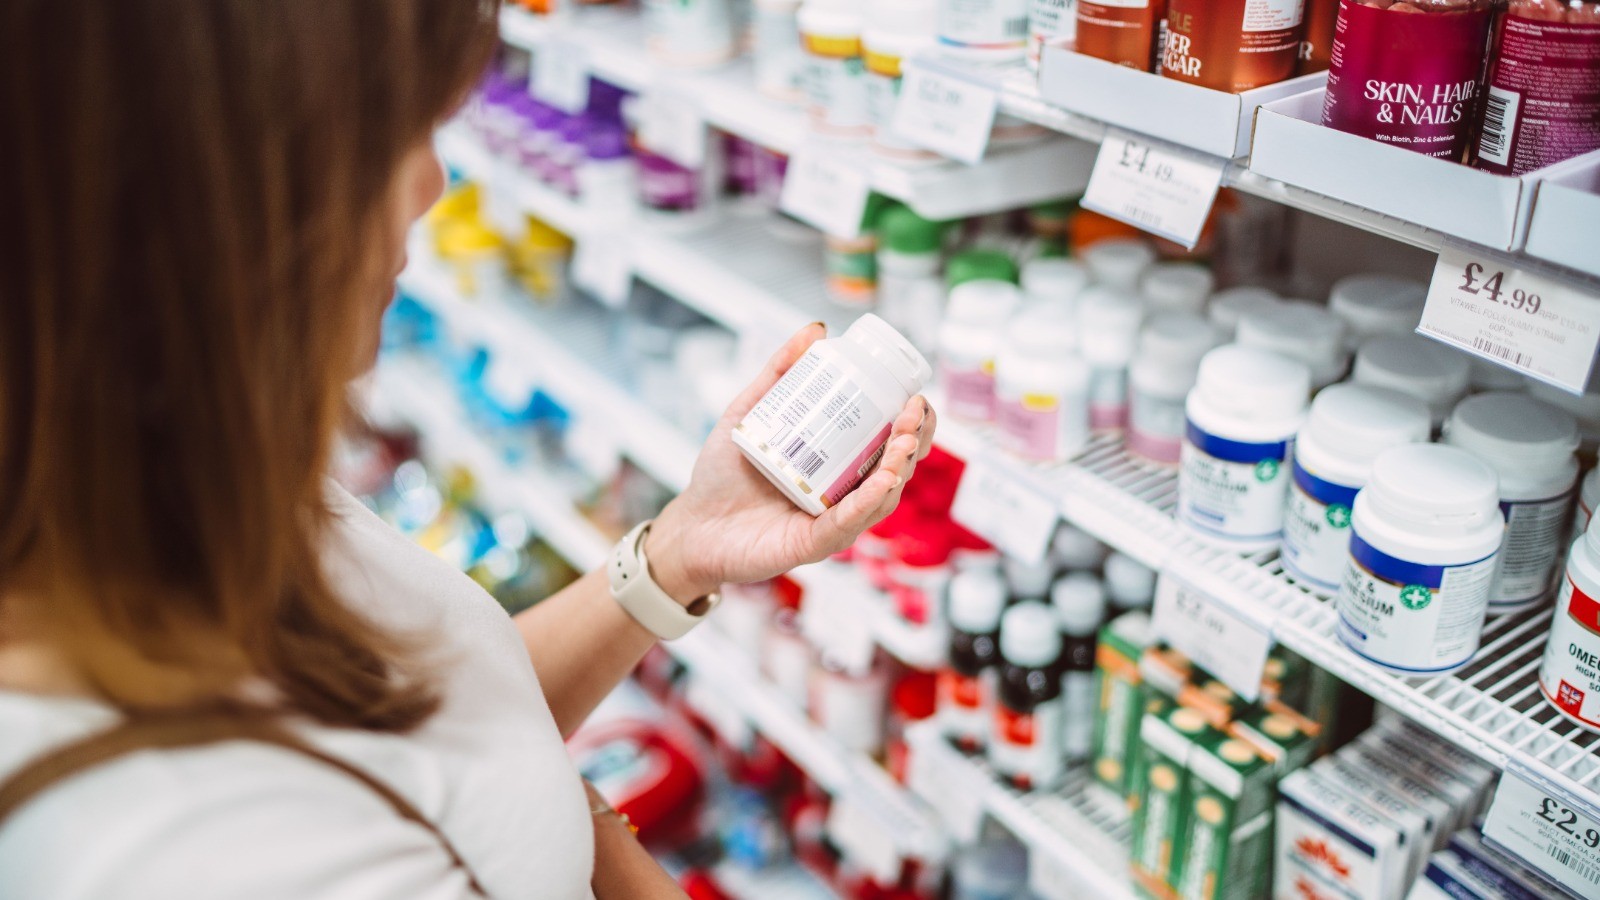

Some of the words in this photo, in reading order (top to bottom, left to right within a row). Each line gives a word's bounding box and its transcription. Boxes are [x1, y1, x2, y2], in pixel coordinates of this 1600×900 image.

[1364, 79, 1425, 105] SKIN,
[1432, 79, 1475, 104] HAIR
[1377, 103, 1393, 123] &
[1400, 102, 1463, 125] NAILS
[1376, 133, 1391, 141] With
[1392, 135, 1412, 143] Biotin,
[1458, 262, 1541, 315] £4.99
[1576, 664, 1596, 680] HIGH
[1536, 797, 1600, 851] £2.9
